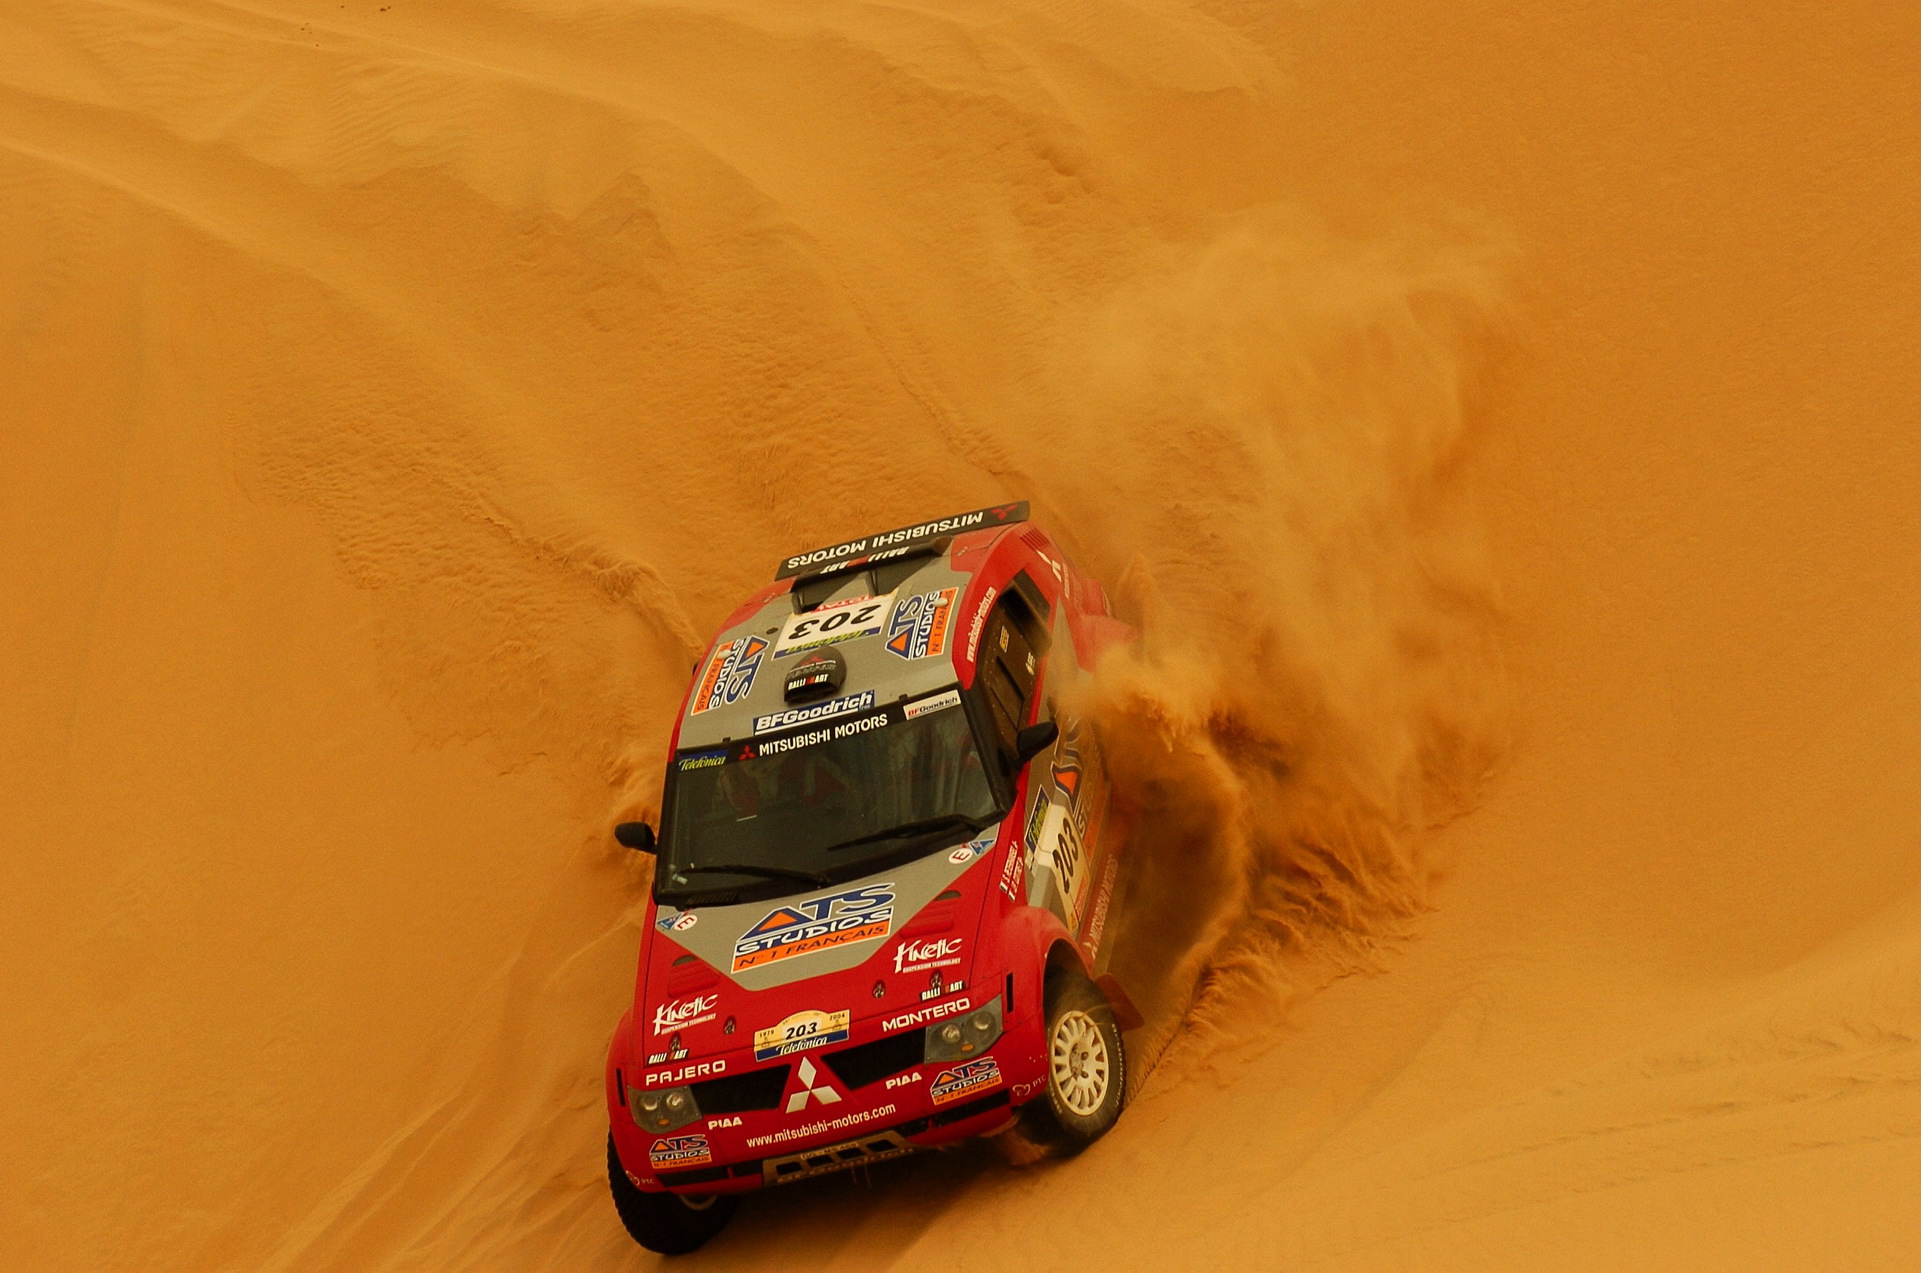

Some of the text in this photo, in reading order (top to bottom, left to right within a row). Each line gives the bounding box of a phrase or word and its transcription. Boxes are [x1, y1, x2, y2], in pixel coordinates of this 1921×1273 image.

[787, 511, 983, 569] MITSUBISHI MOTORS
[788, 604, 881, 639] 203
[885, 594, 924, 660] ATS
[915, 591, 940, 657] STUDIOS
[709, 638, 744, 710] STUDIOS
[725, 635, 770, 705] ATS
[756, 692, 873, 731] BFGoodrich
[908, 697, 958, 717] BFGoodrich
[759, 713, 888, 757] MITSUBISHI MOTORS
[1052, 817, 1079, 894] 203
[736, 882, 897, 942] ATS
[736, 908, 890, 956] STUDIOS
[786, 1022, 818, 1040] 203
[882, 997, 971, 1032] MONTERO
[645, 1060, 726, 1086] PAJERO
[885, 1072, 922, 1090] PIAA
[930, 1056, 997, 1090] ATS
[932, 1070, 999, 1096] STUDIOS
[708, 1116, 742, 1130] PIAA
[746, 1103, 896, 1148] www.mitsubishi-motors.com
[649, 1134, 708, 1154] ATS
[651, 1149, 709, 1161] STUDIOS
